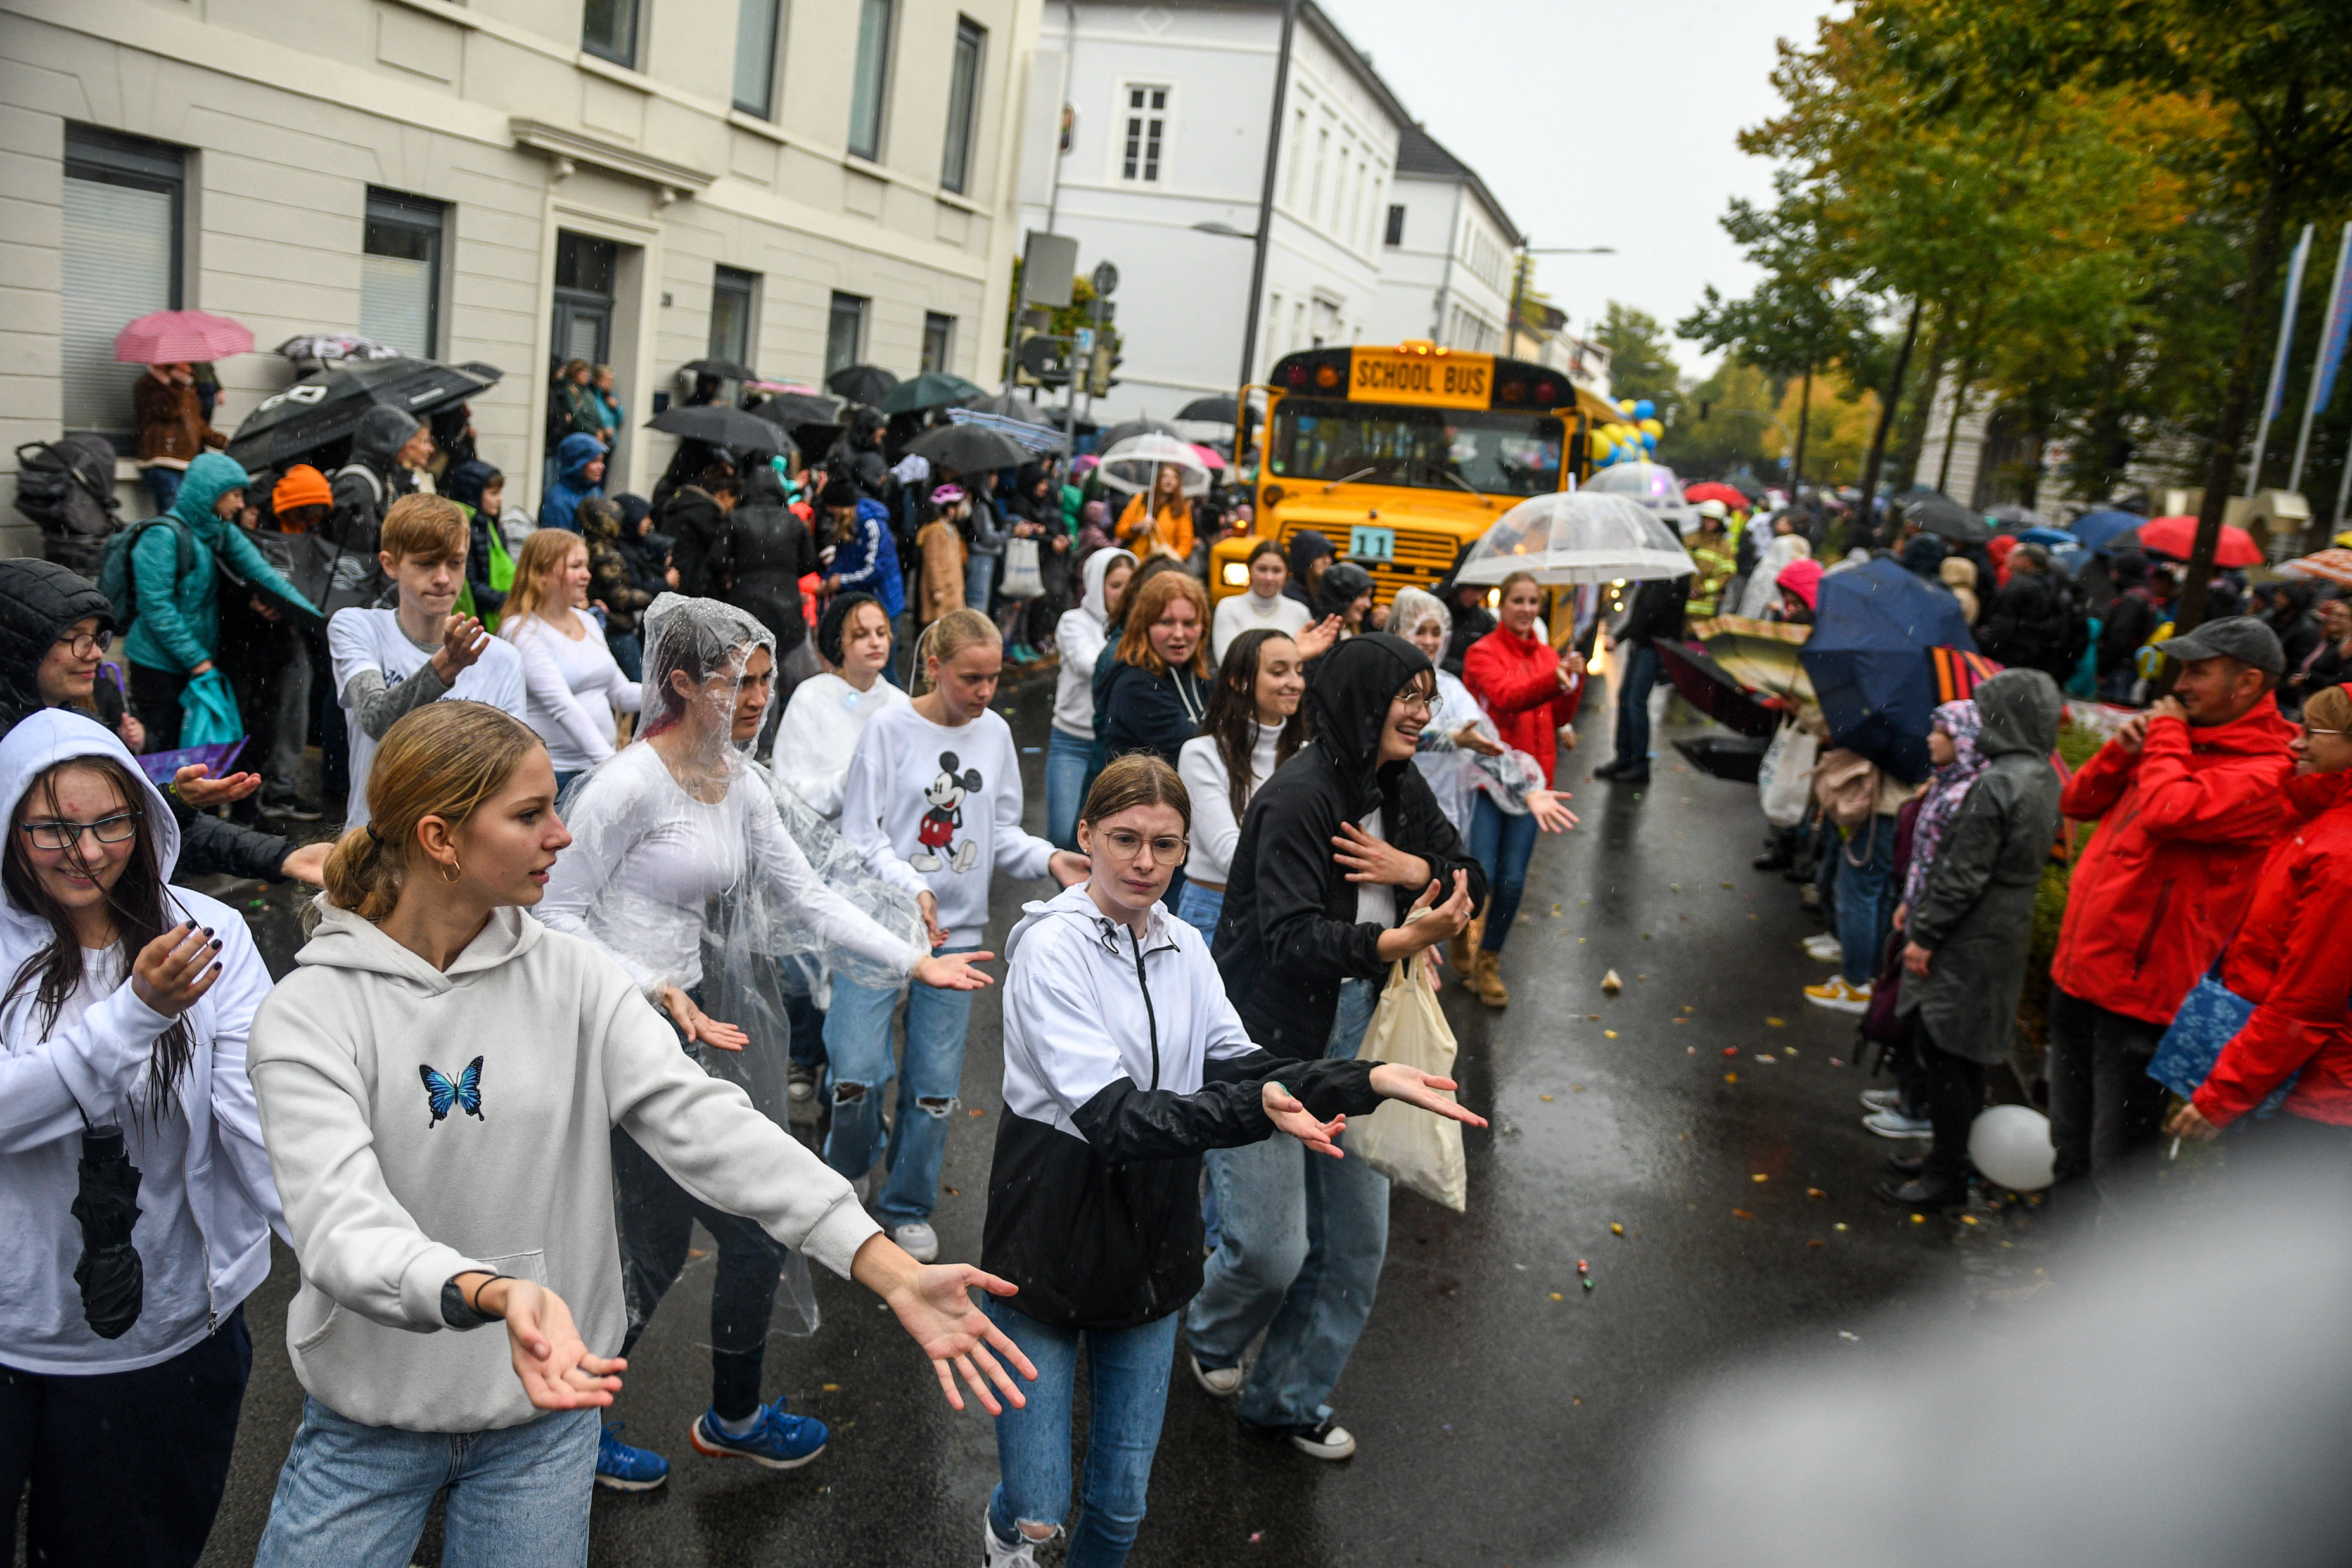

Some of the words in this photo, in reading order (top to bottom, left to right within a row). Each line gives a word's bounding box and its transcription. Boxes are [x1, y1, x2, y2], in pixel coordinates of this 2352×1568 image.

[1357, 360, 1433, 392] SCHOOL
[1444, 365, 1485, 395] BUS
[1356, 533, 1386, 556] 11
